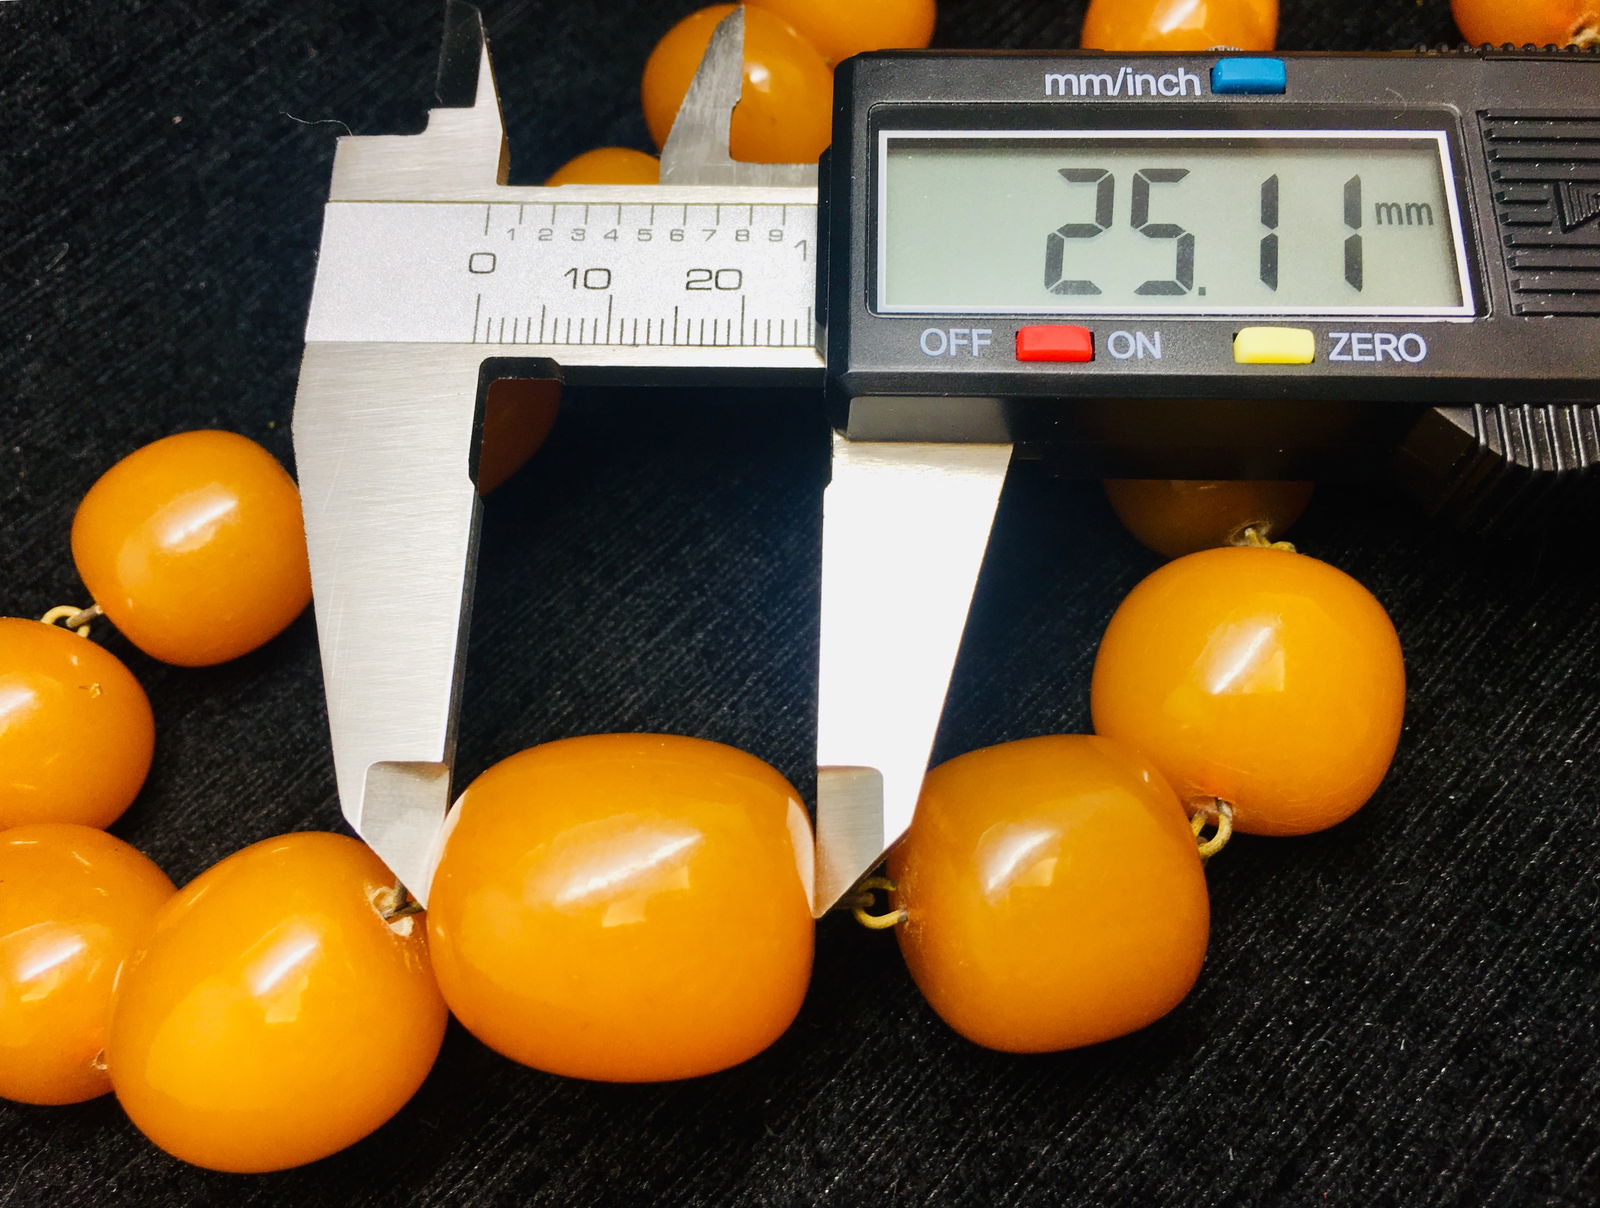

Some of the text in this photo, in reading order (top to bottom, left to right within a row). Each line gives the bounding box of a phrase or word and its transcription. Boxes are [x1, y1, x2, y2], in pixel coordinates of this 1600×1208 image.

[1044, 66, 1202, 98] mm/inch
[507, 228, 783, 242] 1 2 3 4 5 6 7 8 9
[1043, 168, 1435, 296] 25.11 mm
[468, 252, 743, 291] 0 10 20
[919, 328, 1162, 361] OFF ON
[1328, 332, 1427, 364] ZERO
